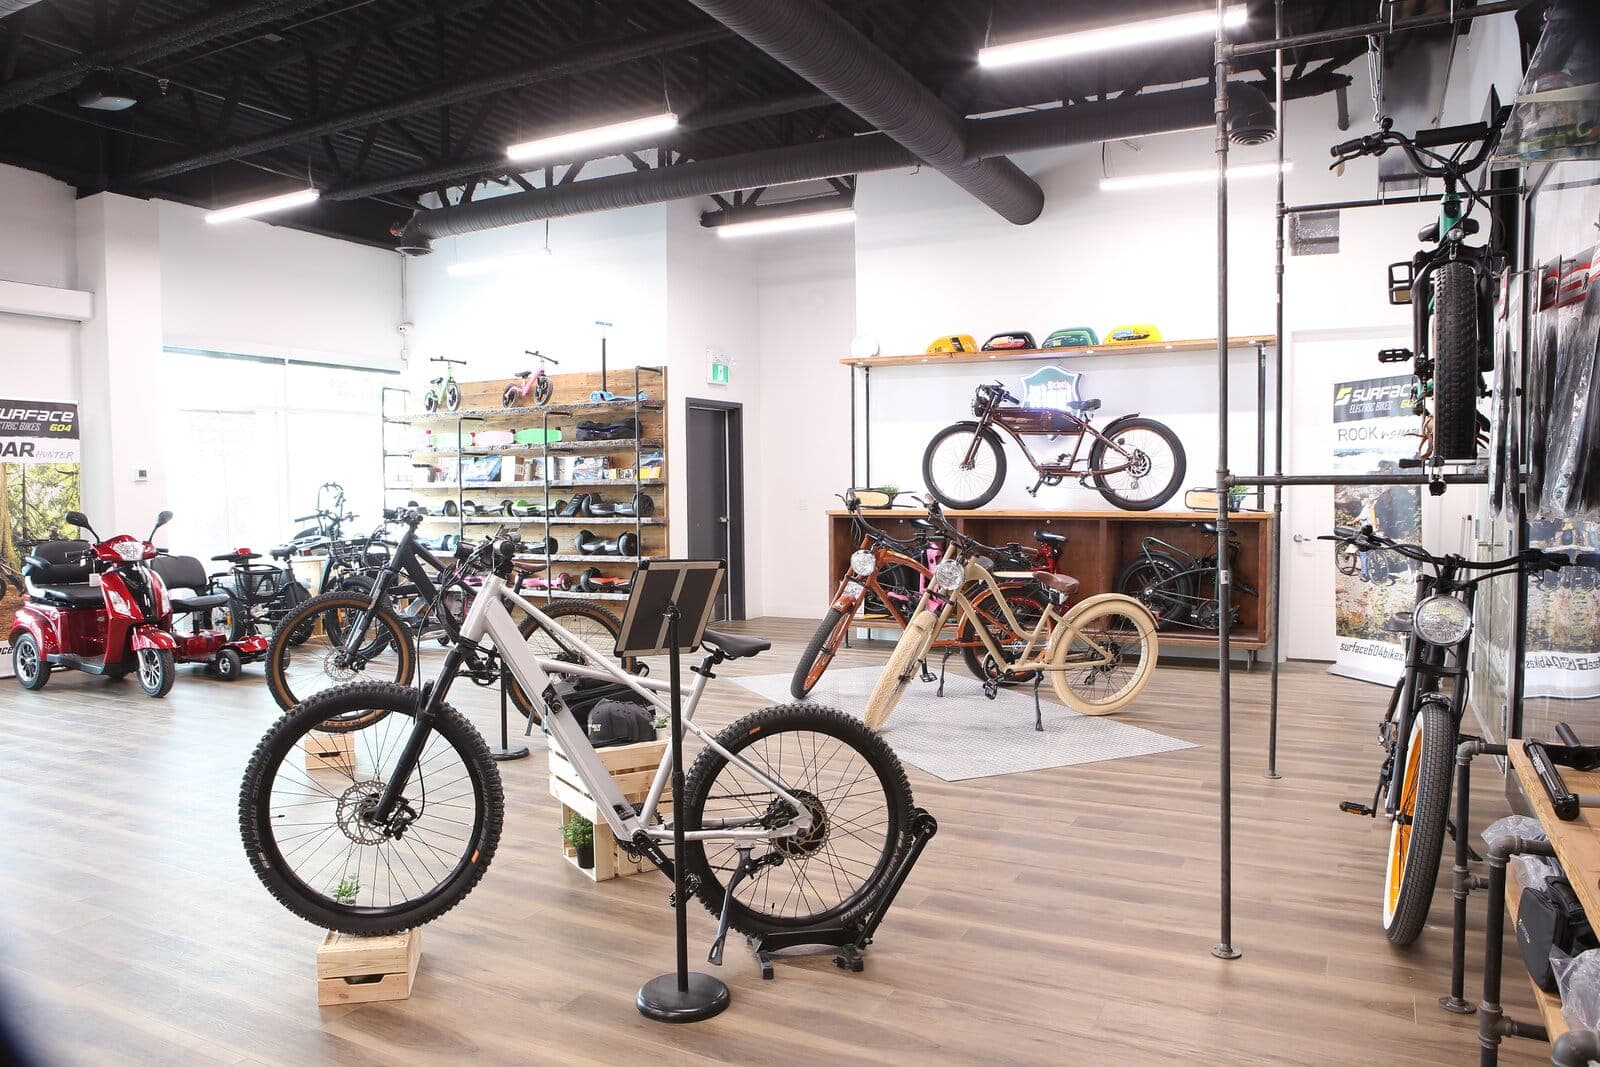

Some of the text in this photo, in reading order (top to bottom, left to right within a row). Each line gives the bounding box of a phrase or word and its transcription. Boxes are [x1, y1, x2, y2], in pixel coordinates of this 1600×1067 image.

[19, 422, 41, 431] BIKES
[49, 424, 72, 432] 604
[1337, 426, 1378, 441] ROOK
[0, 441, 35, 457] AR
[841, 889, 878, 921] MAGIC
